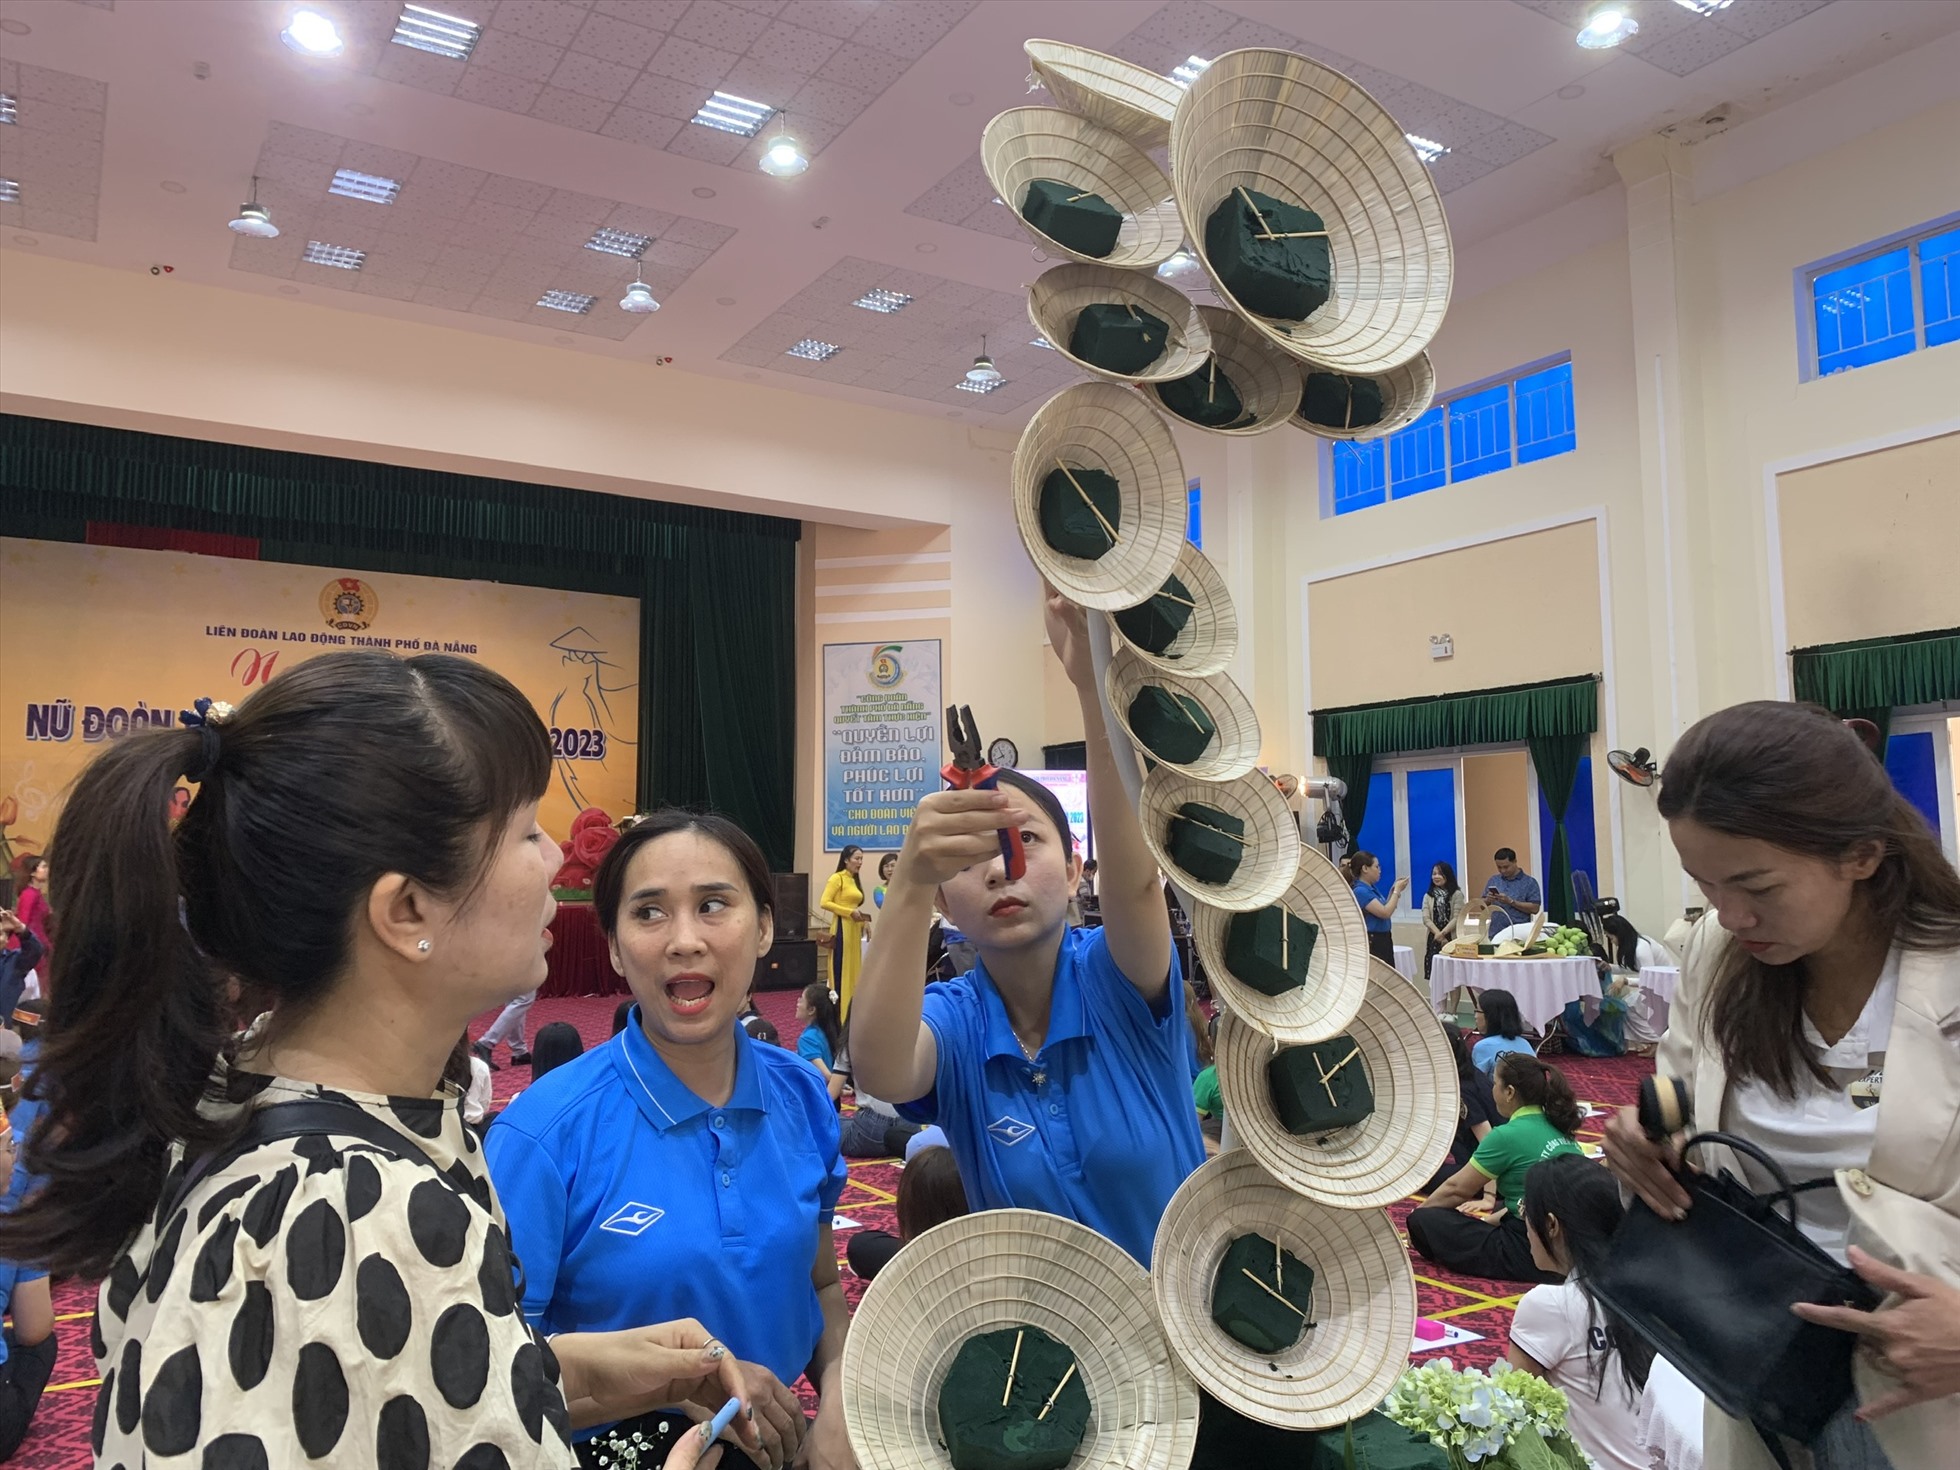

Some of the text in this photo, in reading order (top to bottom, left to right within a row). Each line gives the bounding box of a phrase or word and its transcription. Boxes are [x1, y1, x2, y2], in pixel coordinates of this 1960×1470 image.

[206, 625, 477, 654] LIÊN ĐOÀN LAO ĐỘNG THÀNH PHỐ ĐÀ NẴNG
[26, 699, 75, 742] NỮ
[550, 727, 606, 760] 2023
[904, 725, 934, 743] LỢI
[839, 746, 882, 764] ĐẢM
[843, 766, 923, 783] PHÚC LỢI
[843, 785, 874, 803] TỐT
[870, 806, 897, 819] ĐOÀN
[900, 805, 917, 818] VIÊ
[832, 824, 845, 836] VÀ
[847, 823, 877, 836] NGƯỜI
[880, 824, 900, 836] LAO
